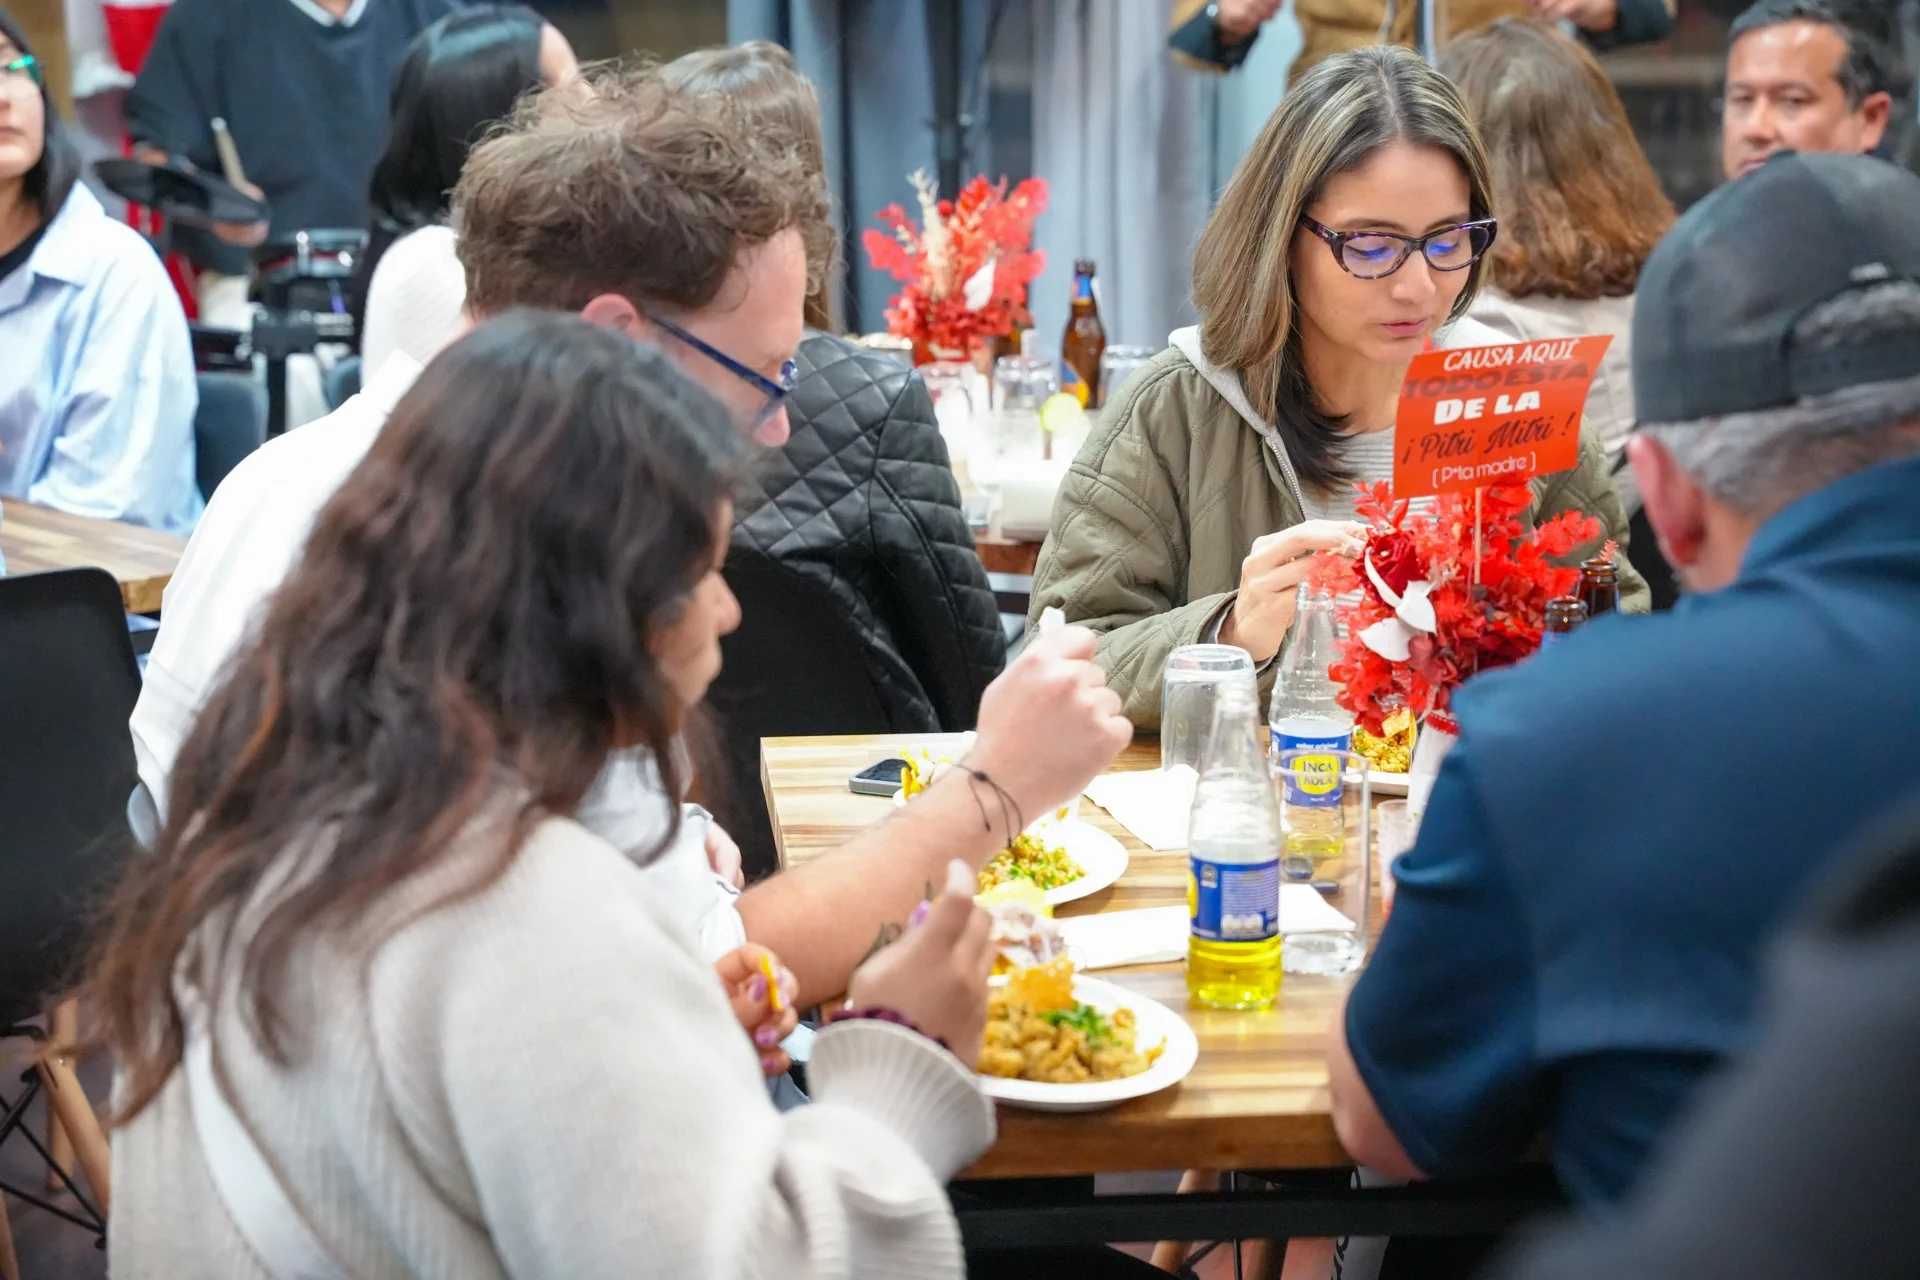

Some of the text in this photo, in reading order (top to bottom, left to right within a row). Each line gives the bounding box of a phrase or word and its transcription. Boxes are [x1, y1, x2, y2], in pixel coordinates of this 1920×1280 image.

[1443, 347, 1513, 372] CAUSA
[1405, 373, 1501, 398] TODO
[1433, 390, 1541, 426] DE LA
[1419, 428, 1477, 463] Pitri
[1483, 415, 1555, 456] Mitri
[1303, 761, 1334, 772] INCA
